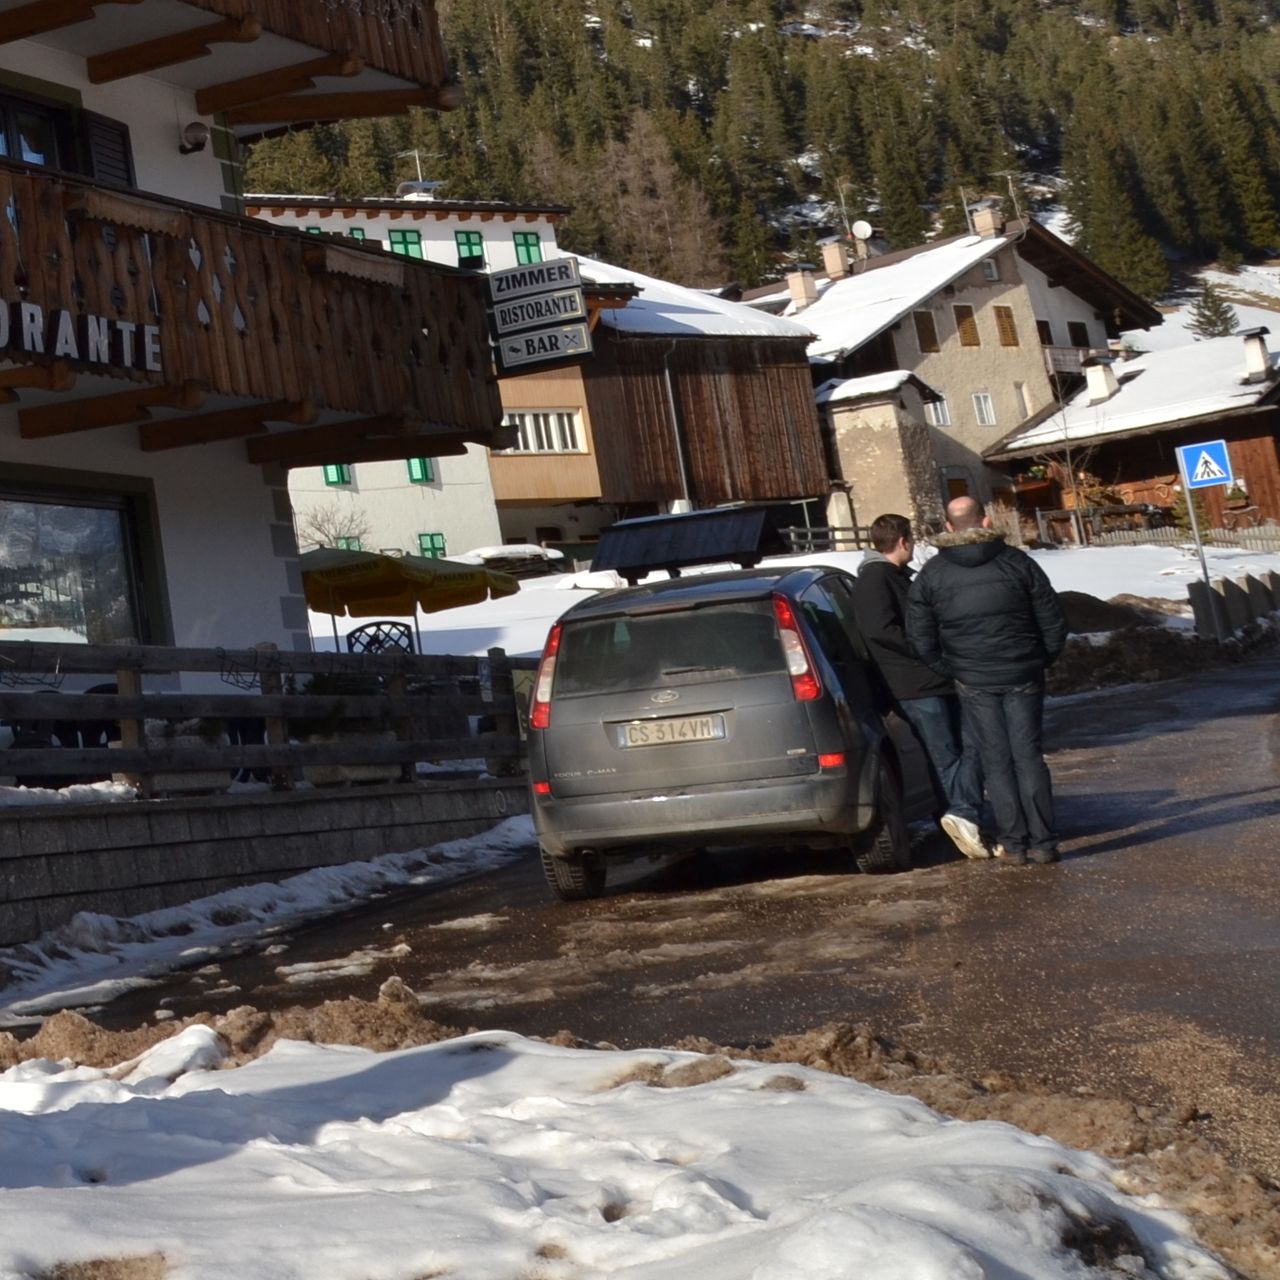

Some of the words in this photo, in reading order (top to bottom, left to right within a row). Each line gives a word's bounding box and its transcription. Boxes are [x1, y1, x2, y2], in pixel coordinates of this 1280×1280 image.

[494, 264, 571, 293] ZIMMER
[499, 294, 578, 327] RISTORANTE
[524, 334, 560, 356] BAR
[628, 724, 649, 745] CS
[656, 718, 712, 742] 314VM
